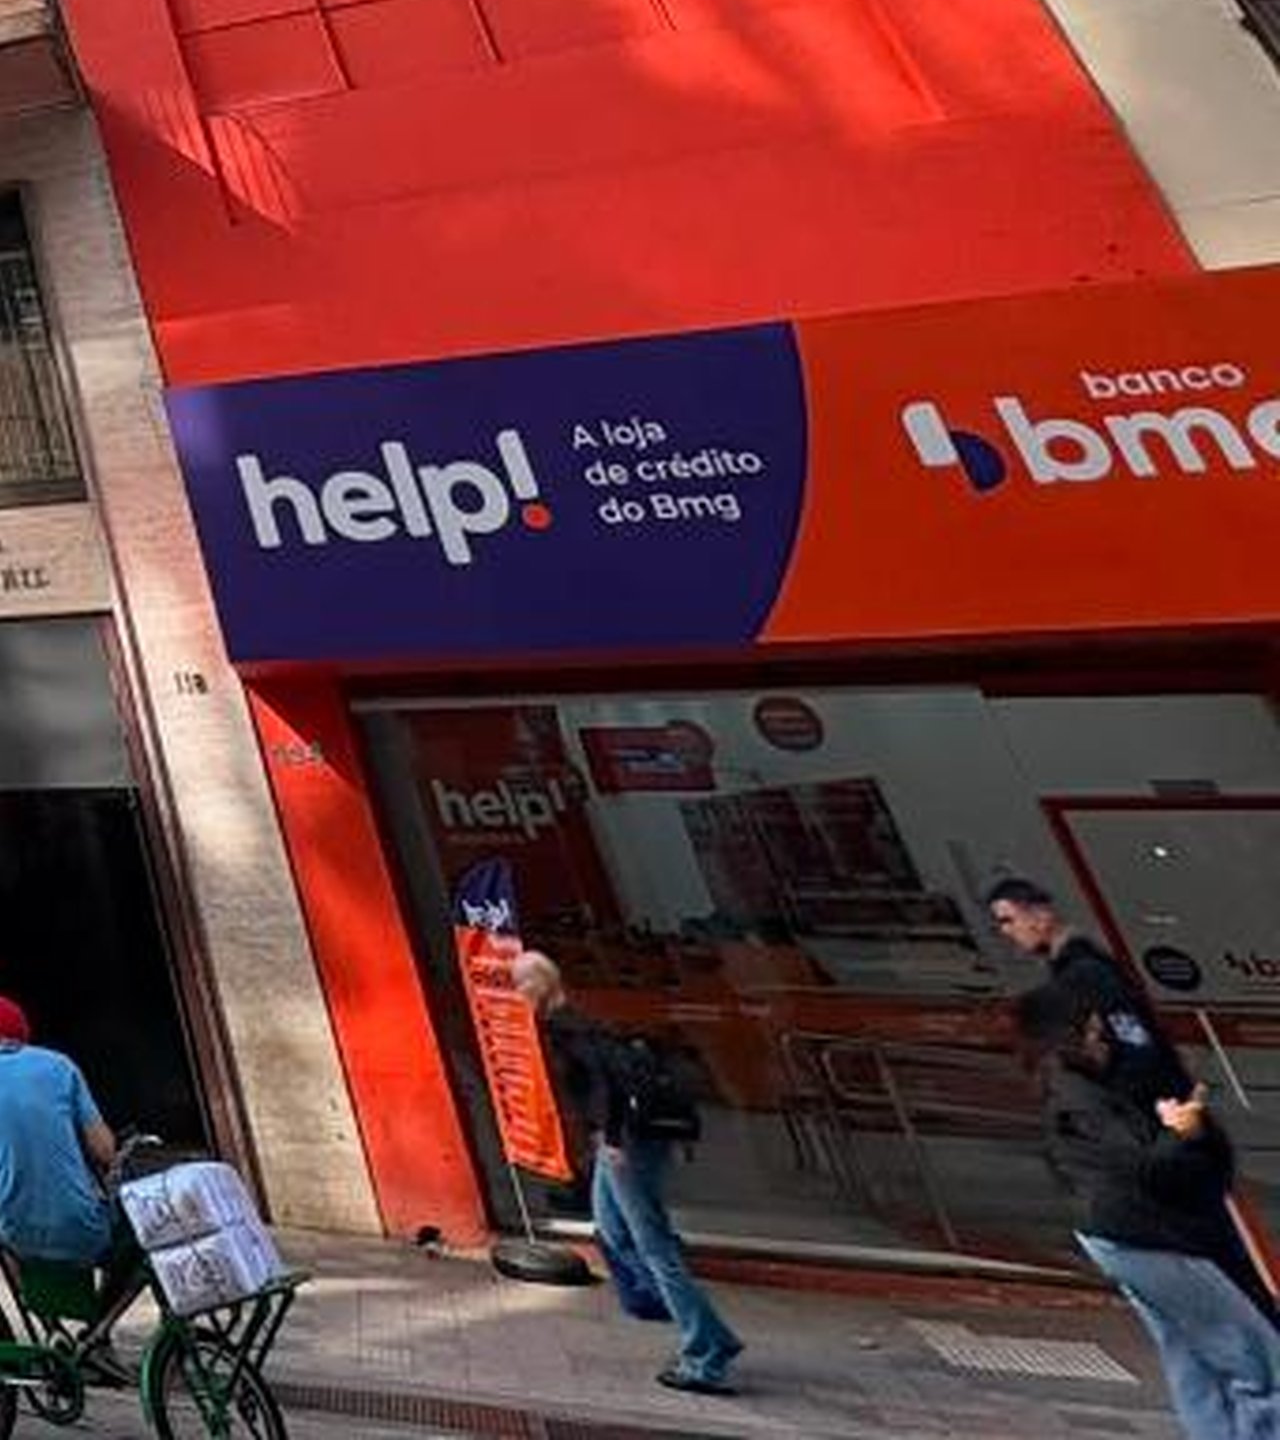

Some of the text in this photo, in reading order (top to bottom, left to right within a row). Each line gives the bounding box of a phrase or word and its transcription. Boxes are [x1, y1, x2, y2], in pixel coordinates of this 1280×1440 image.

[1080, 363, 1246, 398] banco
[572, 417, 667, 451] A loja
[585, 448, 762, 486] de crédito
[236, 429, 553, 565] help!
[598, 492, 741, 525] do Bmg
